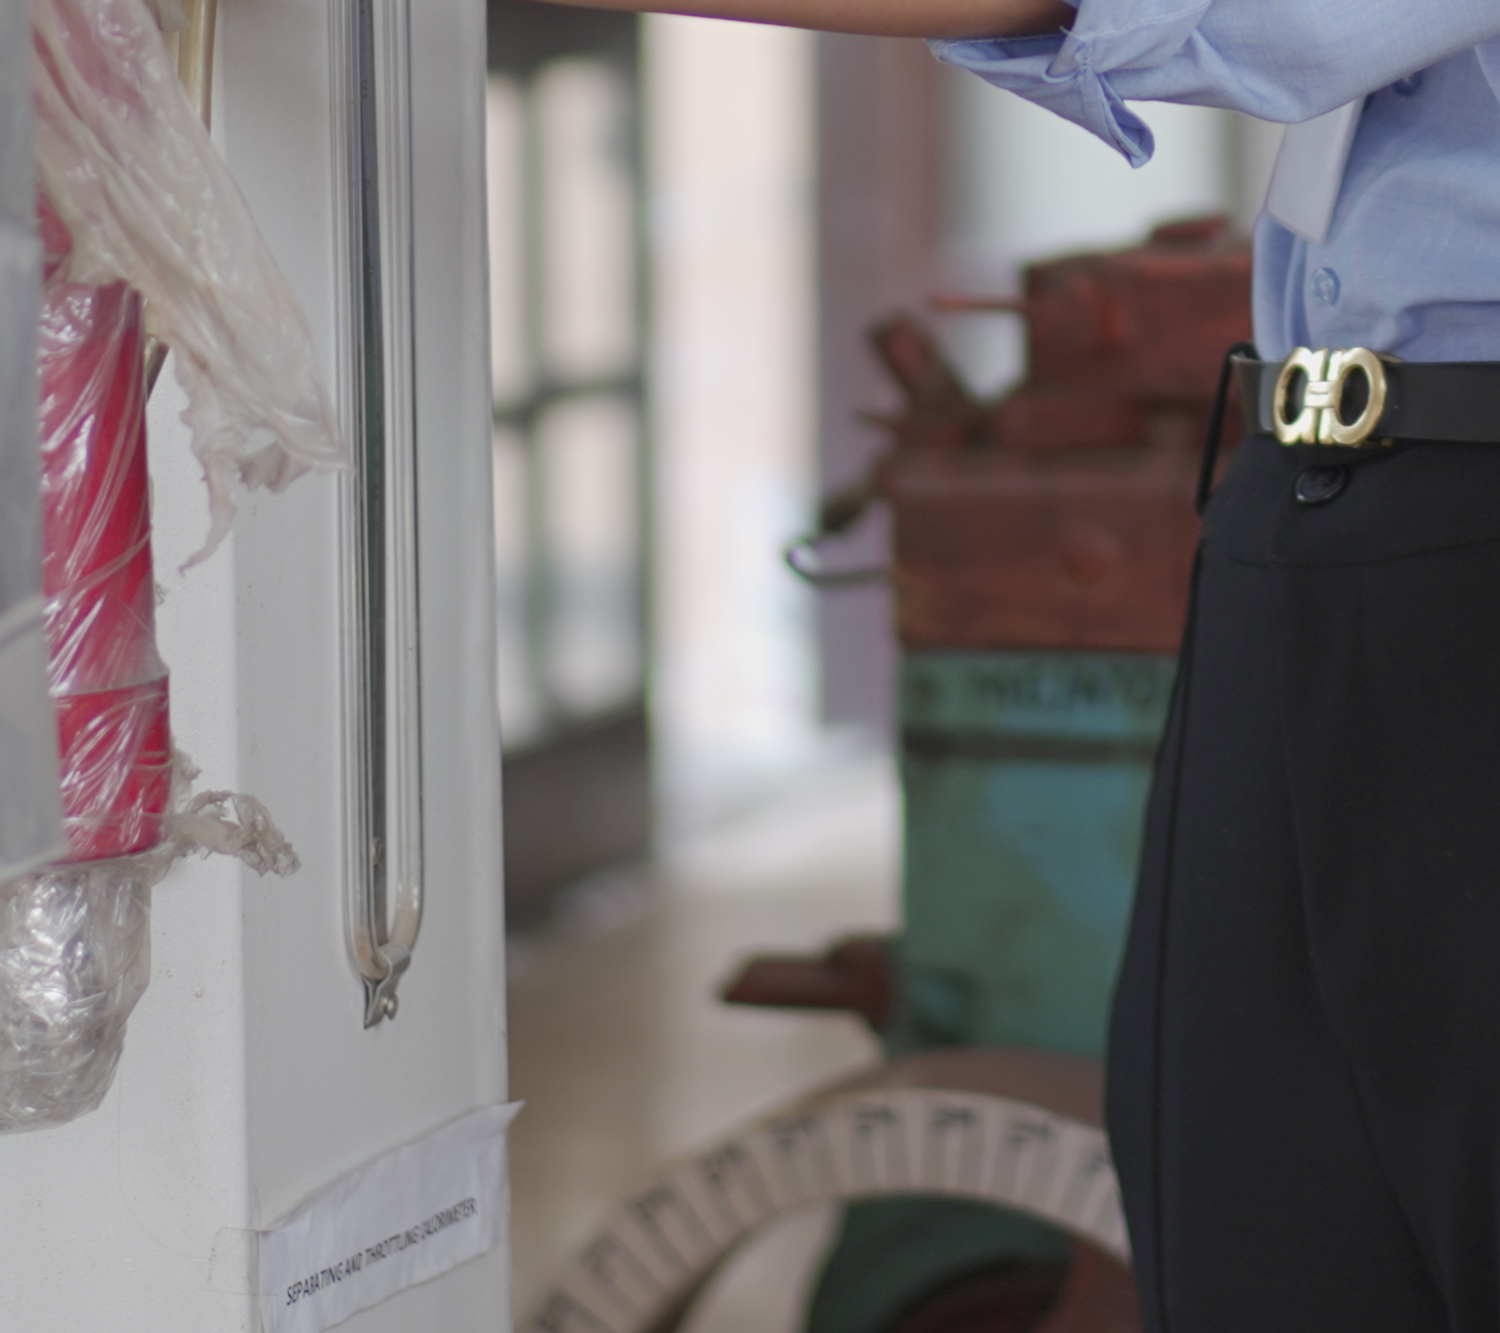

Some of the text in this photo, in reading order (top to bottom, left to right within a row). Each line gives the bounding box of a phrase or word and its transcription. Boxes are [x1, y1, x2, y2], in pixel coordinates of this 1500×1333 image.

[286, 1261, 344, 1306] SEPARATING
[345, 1252, 363, 1276] AND
[364, 1226, 420, 1268] THROTTLING
